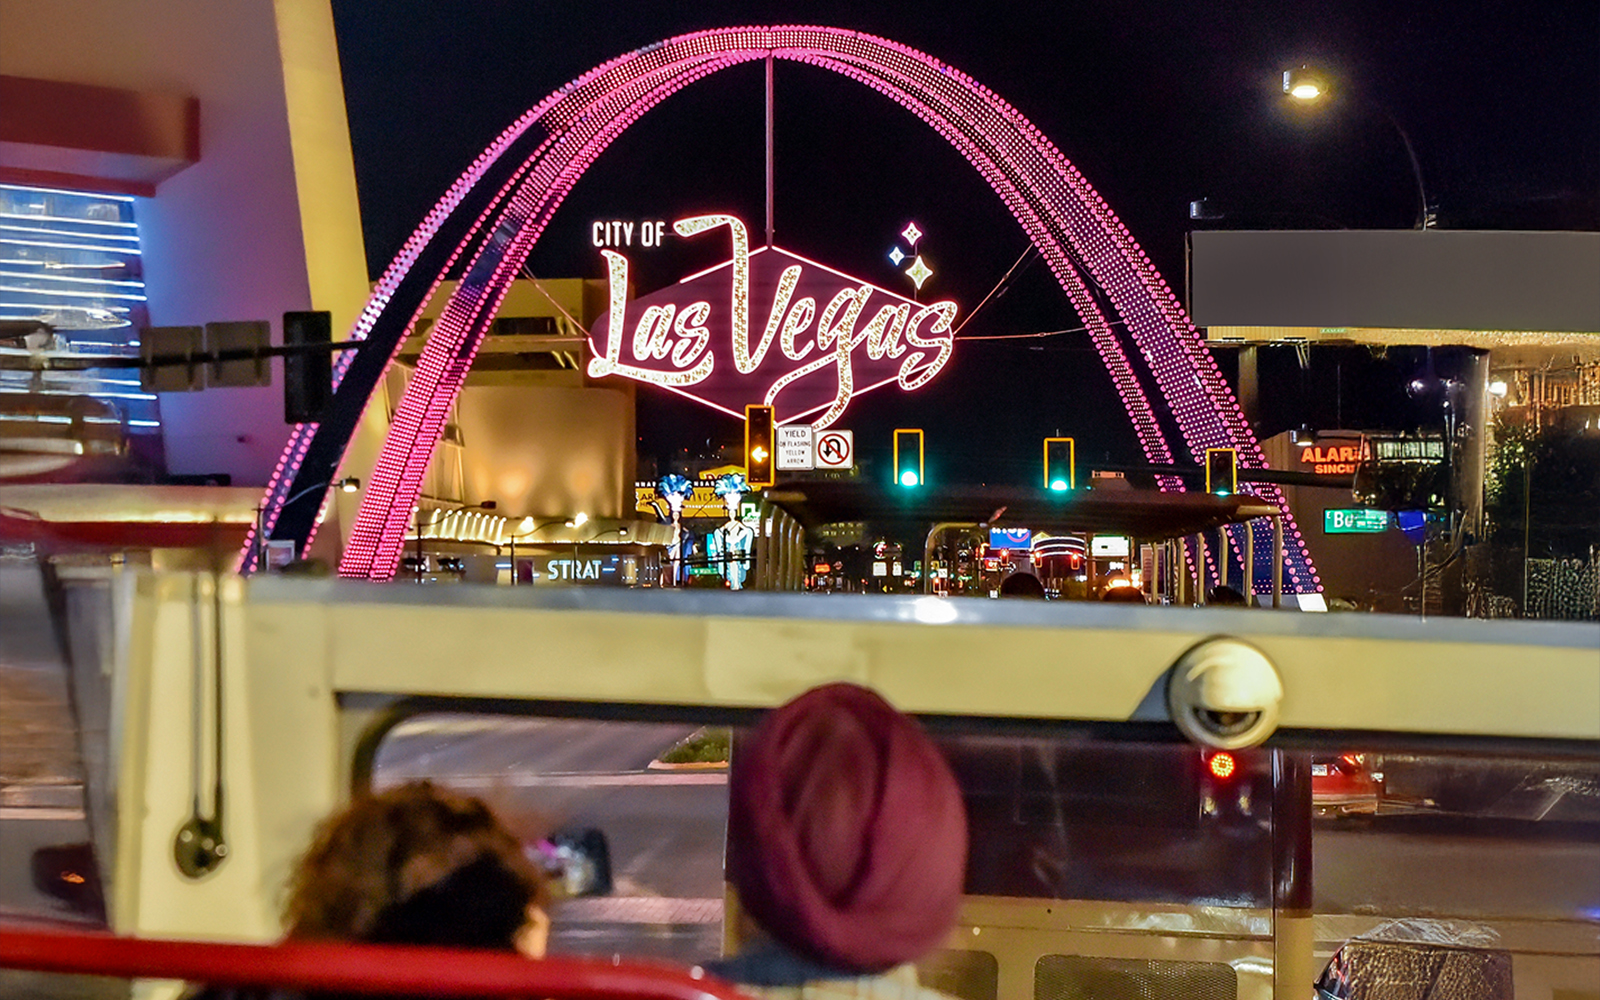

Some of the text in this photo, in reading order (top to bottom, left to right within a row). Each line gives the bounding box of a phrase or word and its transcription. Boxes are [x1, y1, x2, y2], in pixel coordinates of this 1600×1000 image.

[592, 221, 665, 247] CITY OF
[587, 214, 958, 431] Las Vegas
[784, 430, 806, 438] YIELD
[547, 560, 601, 580] STRAT
